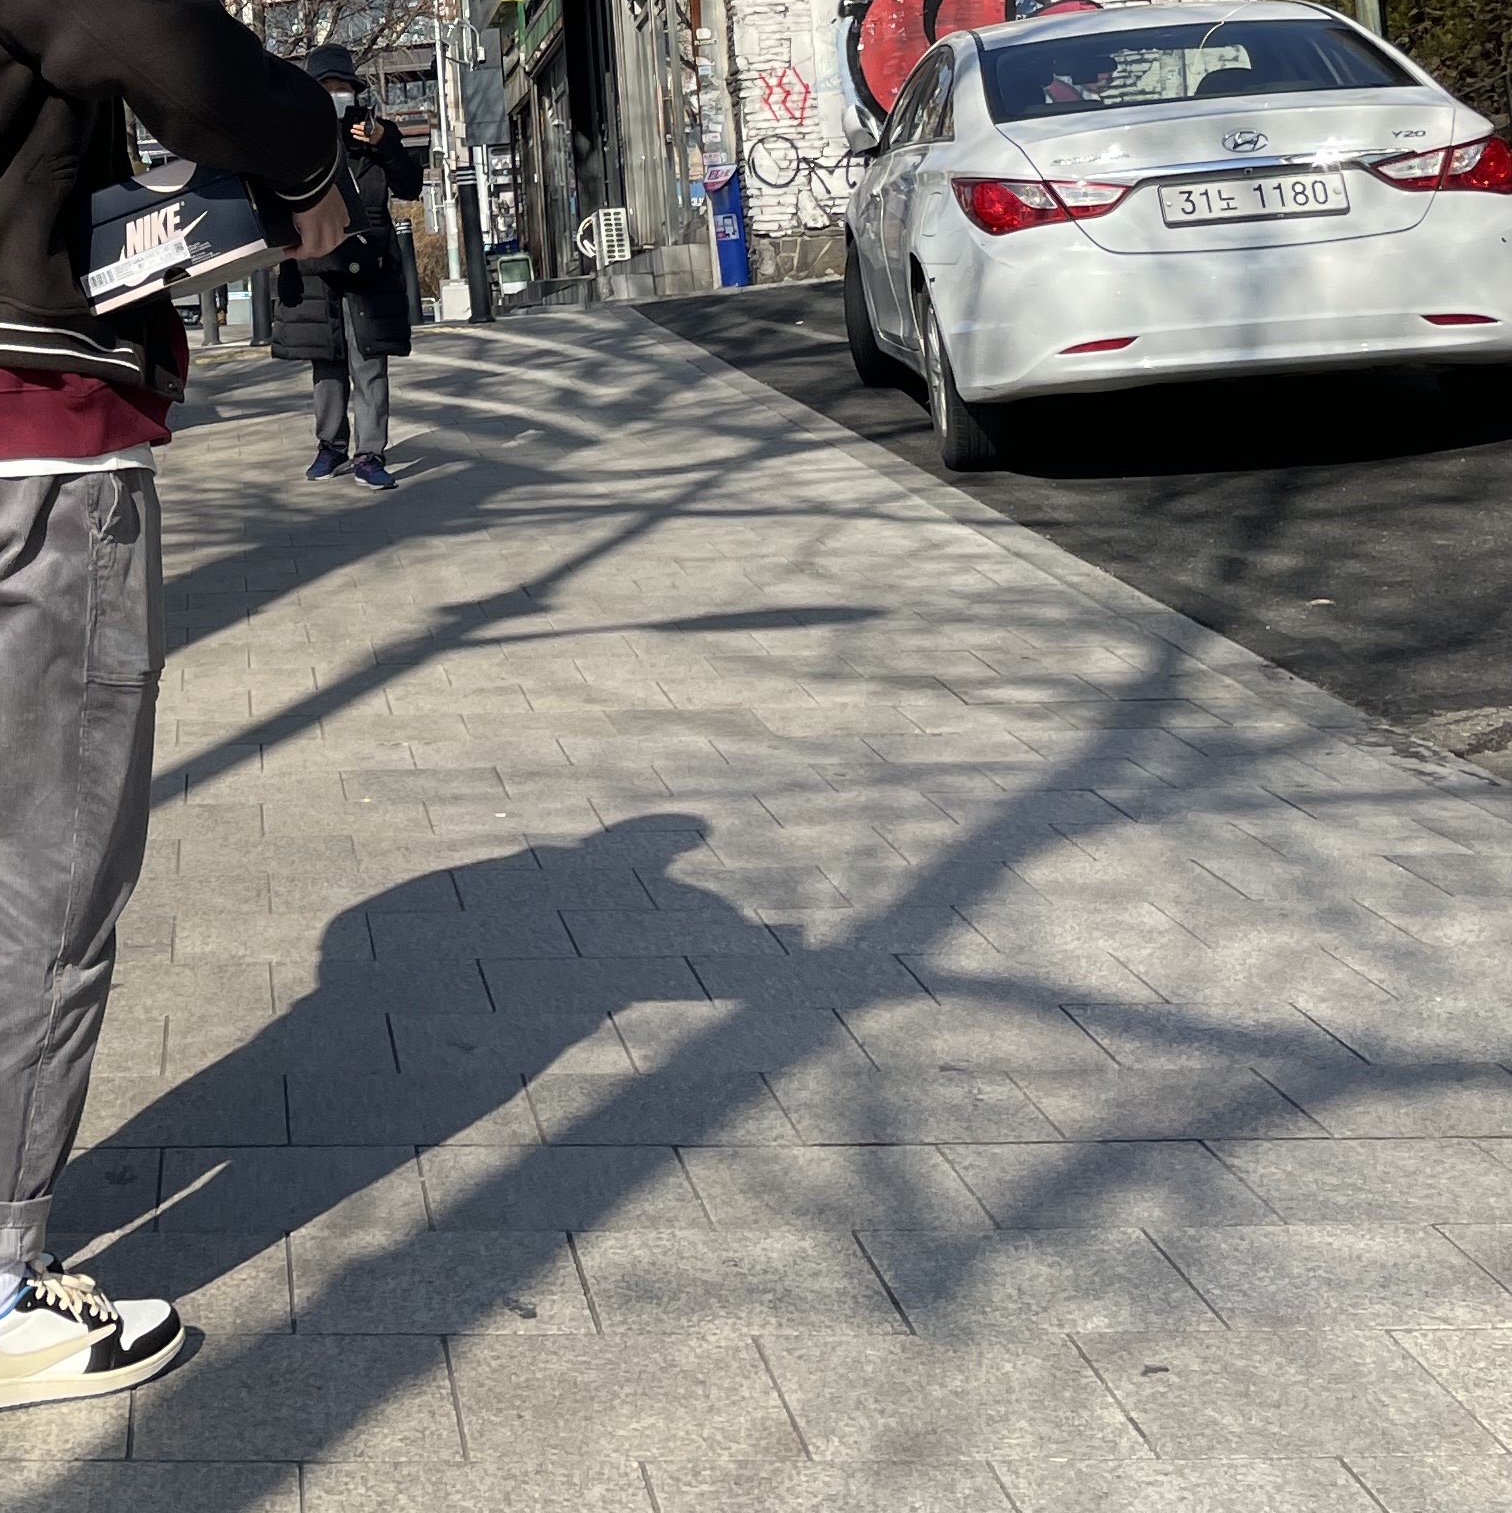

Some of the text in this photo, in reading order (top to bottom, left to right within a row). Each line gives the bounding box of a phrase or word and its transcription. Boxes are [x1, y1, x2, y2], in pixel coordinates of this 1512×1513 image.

[1391, 130, 1427, 138] Y20
[1179, 179, 1329, 216] 31노 1180
[125, 202, 182, 258] NIKE
